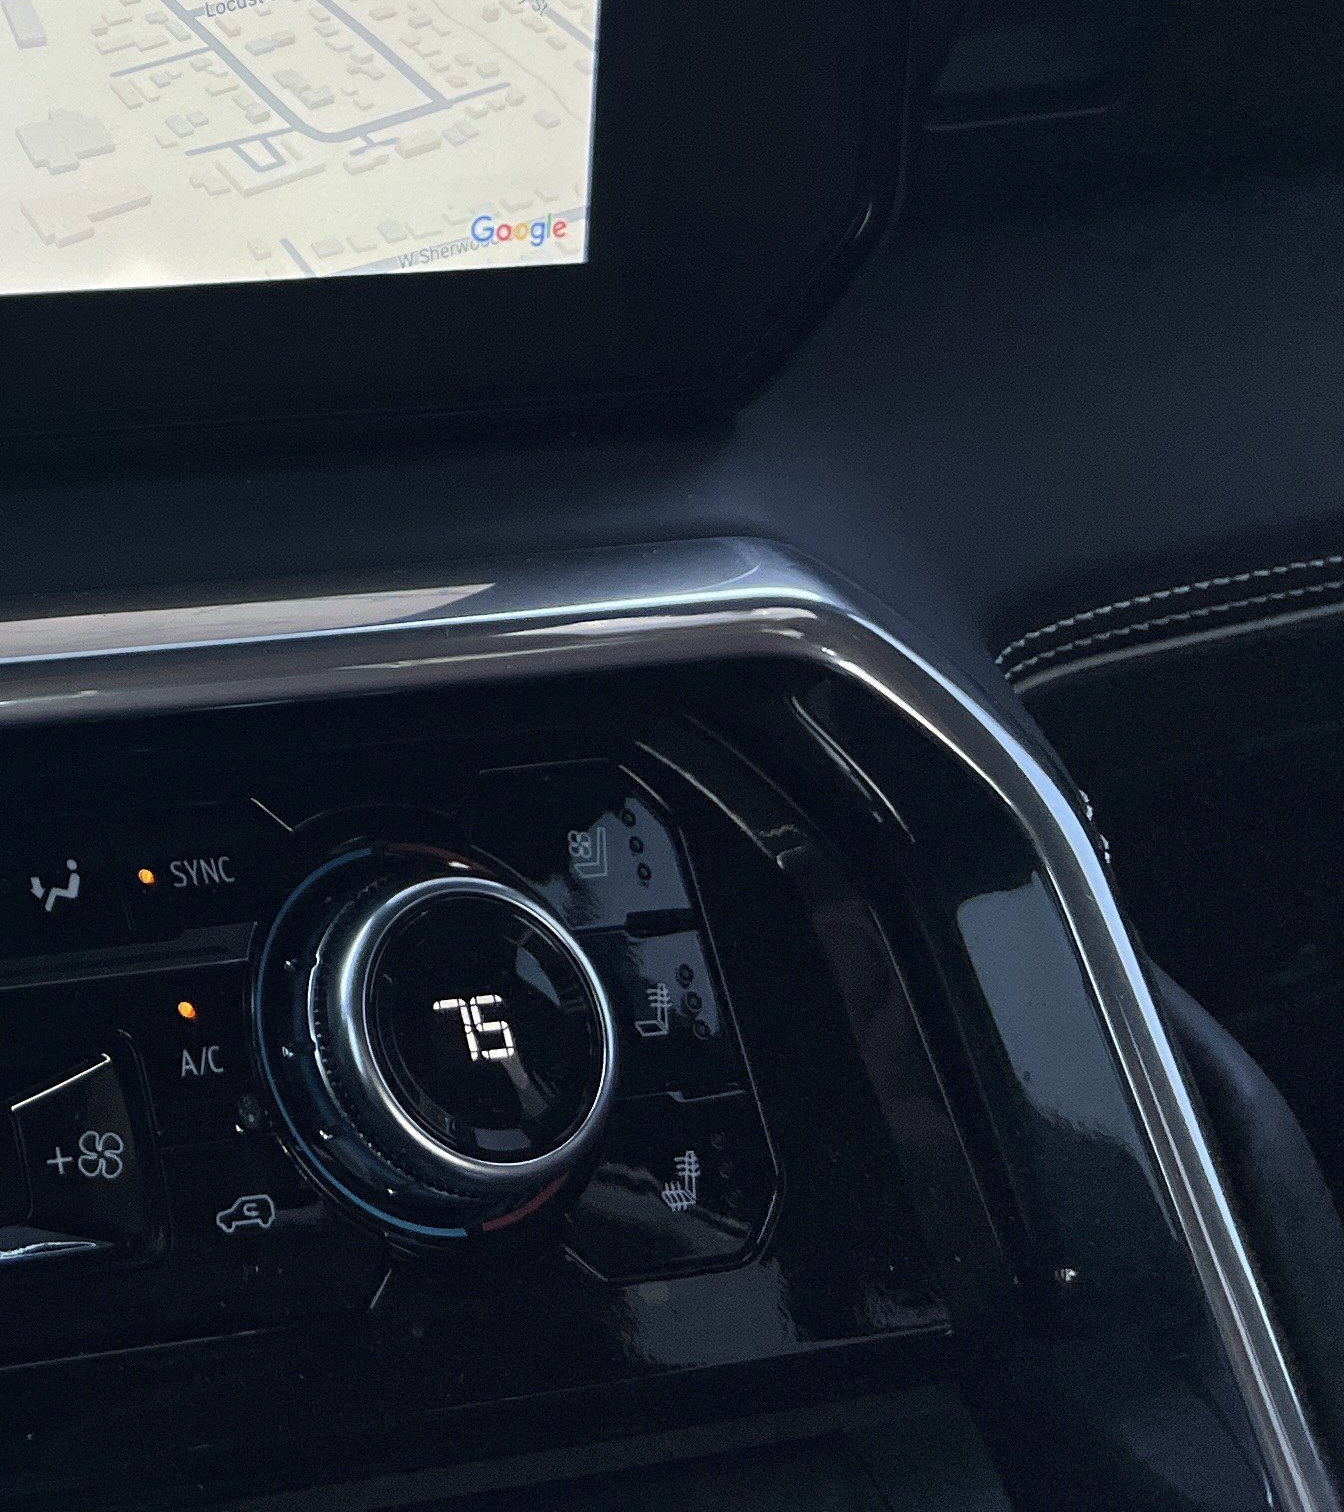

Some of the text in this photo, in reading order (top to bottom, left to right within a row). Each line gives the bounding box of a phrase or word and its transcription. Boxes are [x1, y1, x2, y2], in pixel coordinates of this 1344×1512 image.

[470, 212, 568, 248] Google
[397, 253, 414, 270] W
[170, 856, 236, 889] SYNC
[432, 994, 515, 1061] 75
[180, 1046, 224, 1077] A/C
